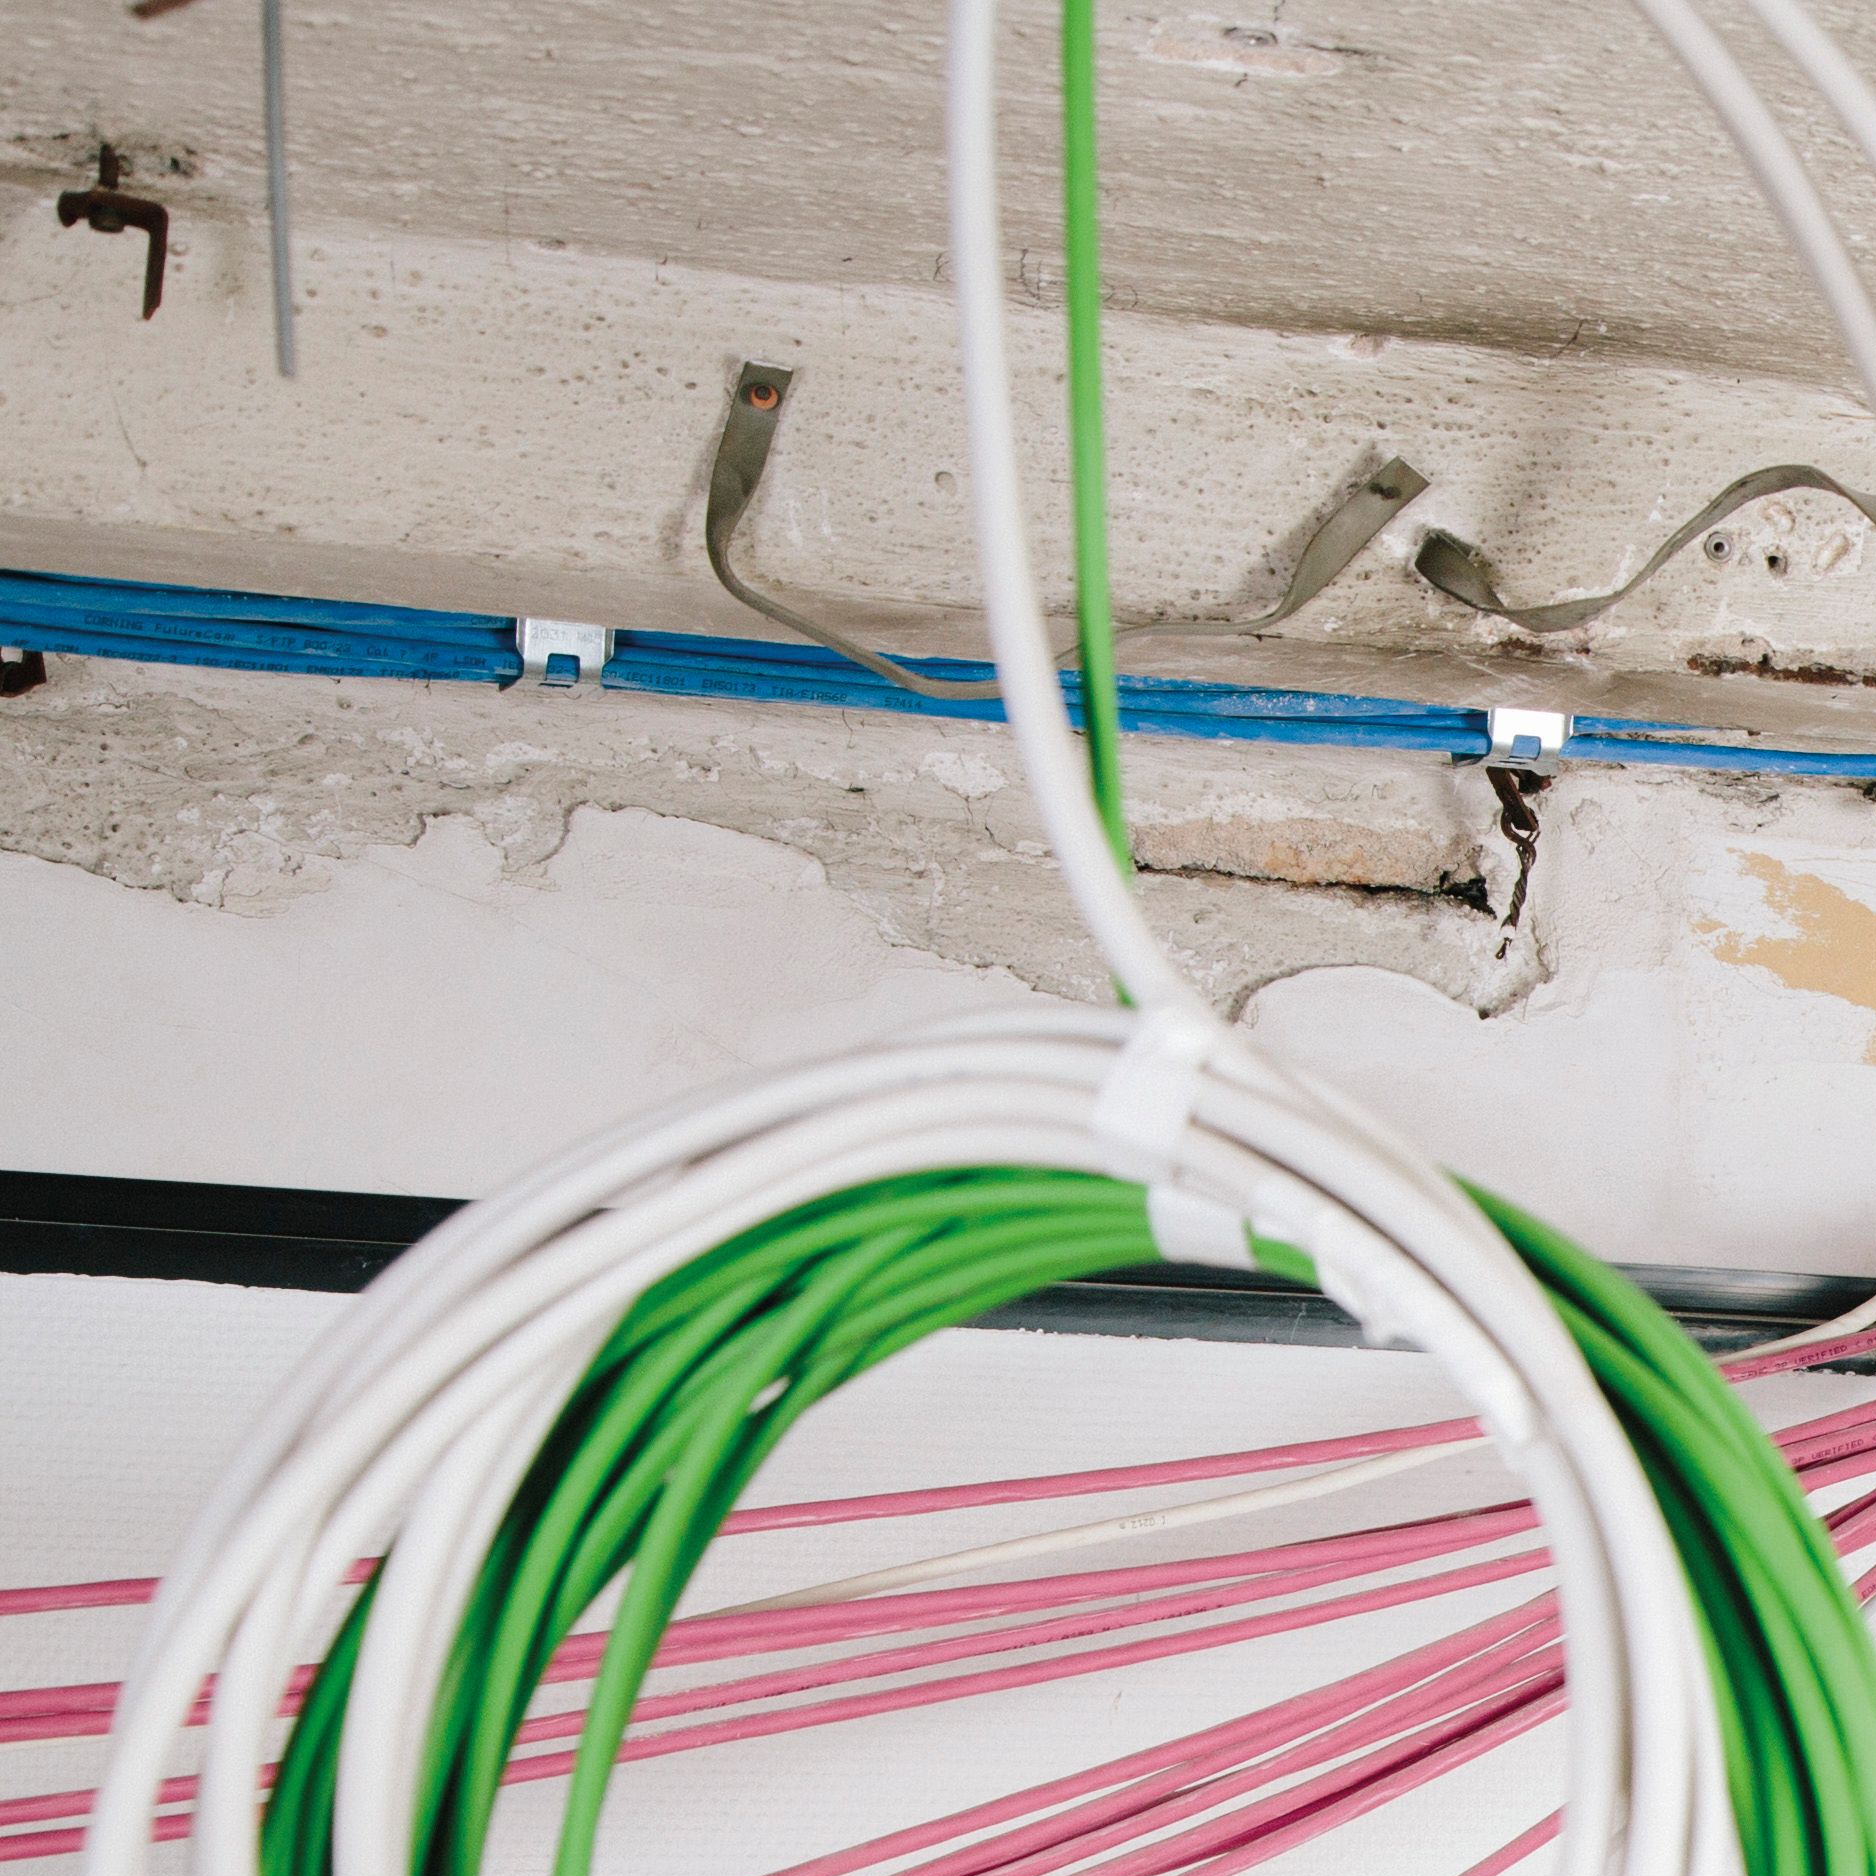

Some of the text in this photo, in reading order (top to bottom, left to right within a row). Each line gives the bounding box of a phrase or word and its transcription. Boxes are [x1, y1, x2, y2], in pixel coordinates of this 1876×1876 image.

[602, 670, 686, 688] SO/IEC11801
[1793, 1344, 1848, 1366] VERIFIED
[1811, 1438, 1864, 1462] VERIFIED
